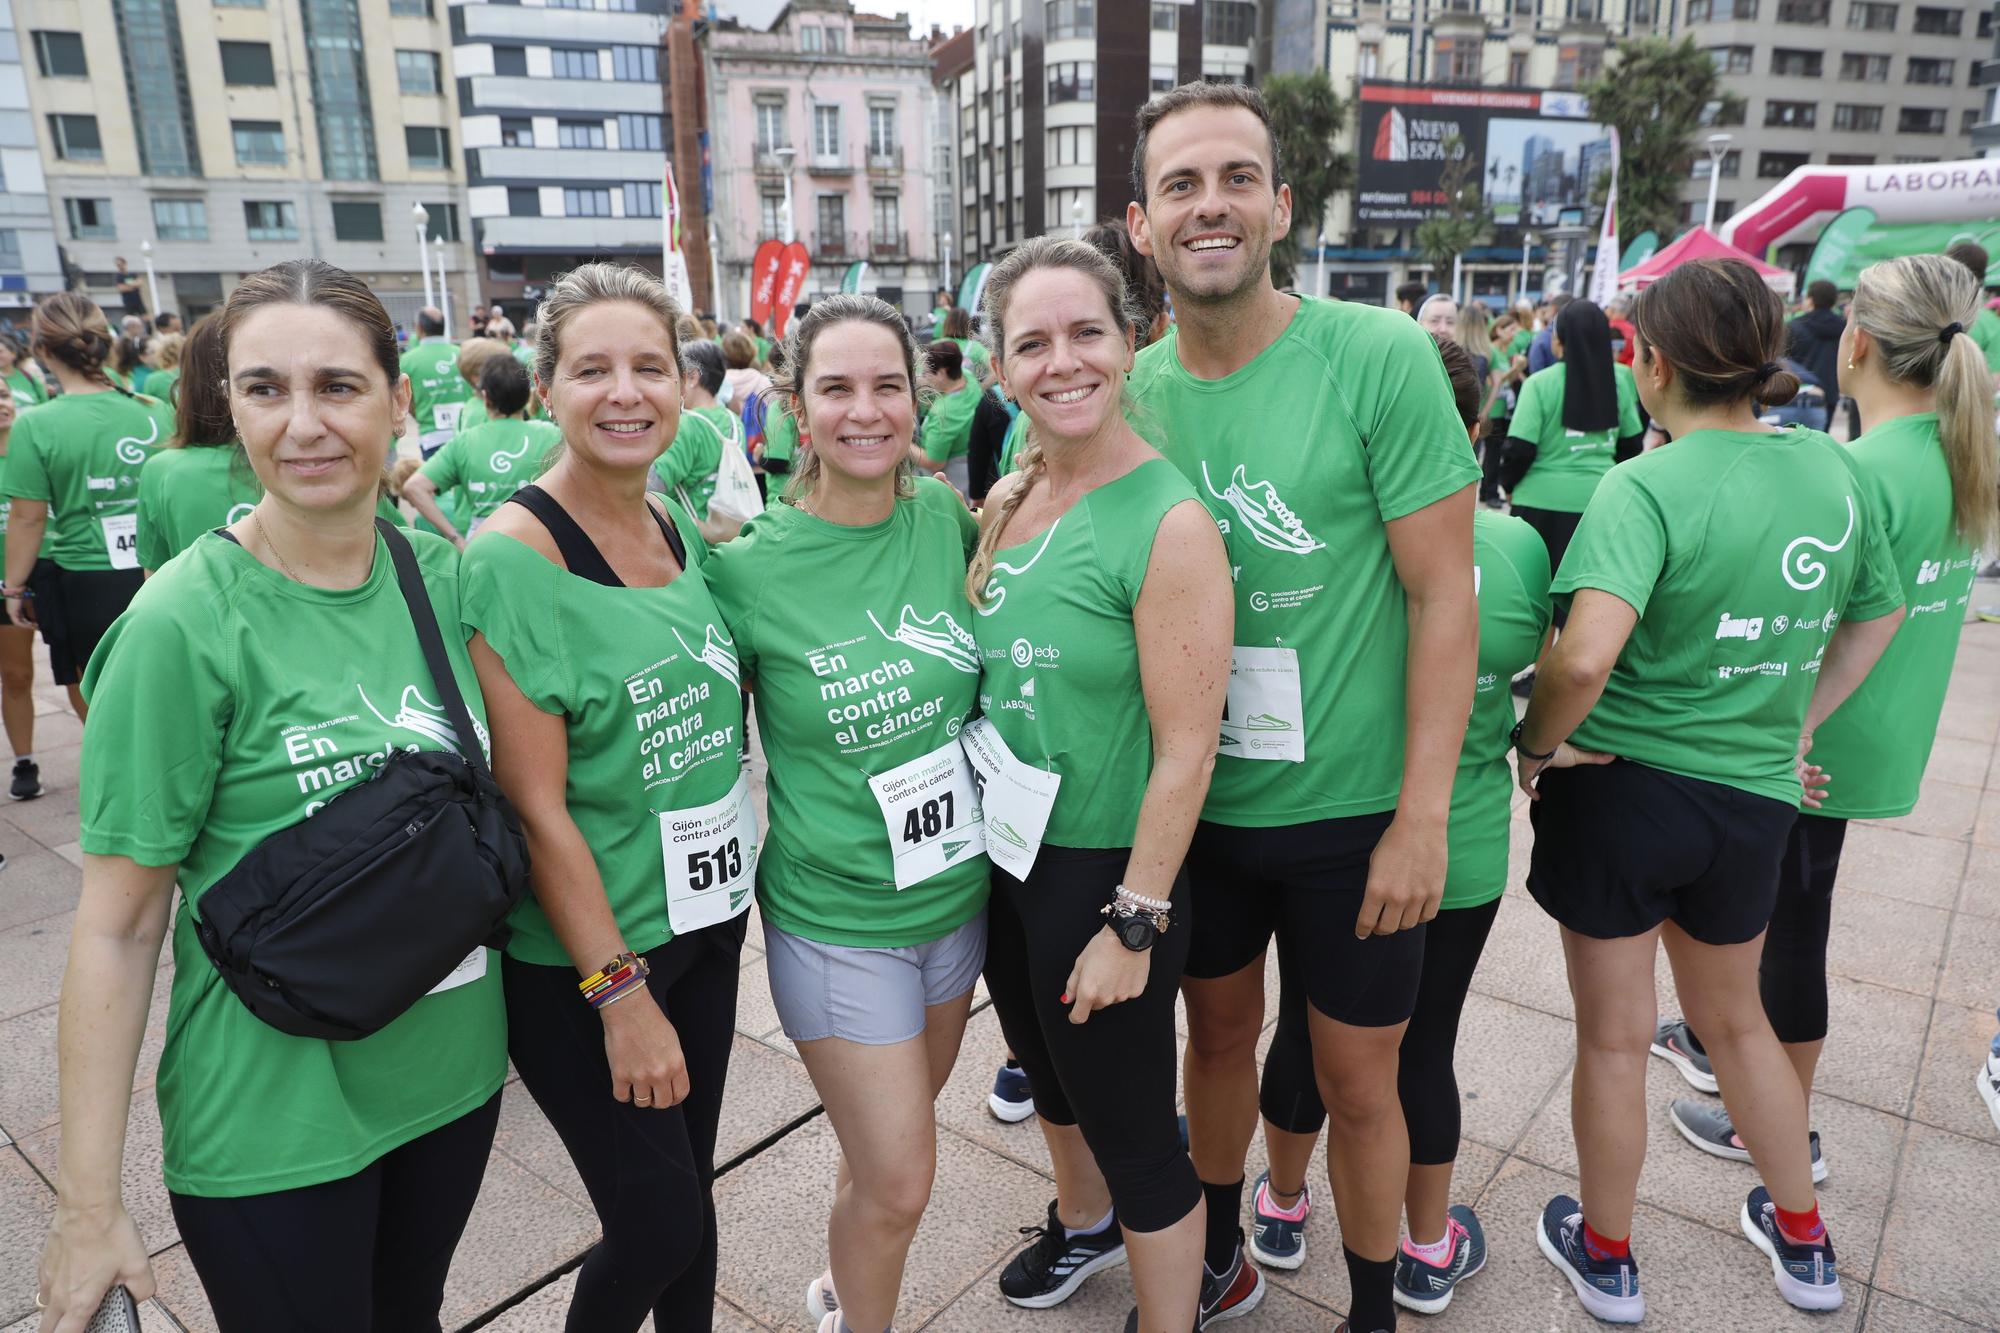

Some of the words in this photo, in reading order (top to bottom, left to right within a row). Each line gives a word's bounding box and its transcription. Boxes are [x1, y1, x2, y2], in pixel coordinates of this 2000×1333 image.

[1409, 141, 1466, 161] ESPAO
[1865, 167, 2000, 193] LABORA
[808, 652, 848, 678] En
[1034, 643, 1060, 662] edp
[626, 676, 664, 705] En
[820, 657, 915, 701] marcha
[1477, 672, 1497, 685] edp
[635, 681, 711, 732] marcha
[827, 685, 912, 725] contra
[834, 724, 859, 745] el
[866, 695, 944, 739] cáncer
[285, 733, 339, 766] En
[640, 712, 703, 756] contra
[642, 752, 662, 780] el
[669, 725, 734, 770] cáncer
[964, 728, 979, 749] contra
[977, 745, 985, 755] el
[981, 752, 1001, 775] cáncer
[881, 777, 908, 794] Gijón
[907, 772, 920, 784] en
[921, 757, 952, 779] marcha
[887, 786, 918, 804] contra
[918, 778, 929, 791] el
[929, 766, 956, 787] cáncer
[672, 819, 702, 833] Gijón
[704, 814, 718, 826] en
[673, 830, 711, 843] contra
[712, 825, 722, 835] el
[903, 790, 955, 845] 487
[687, 836, 742, 892] 513
